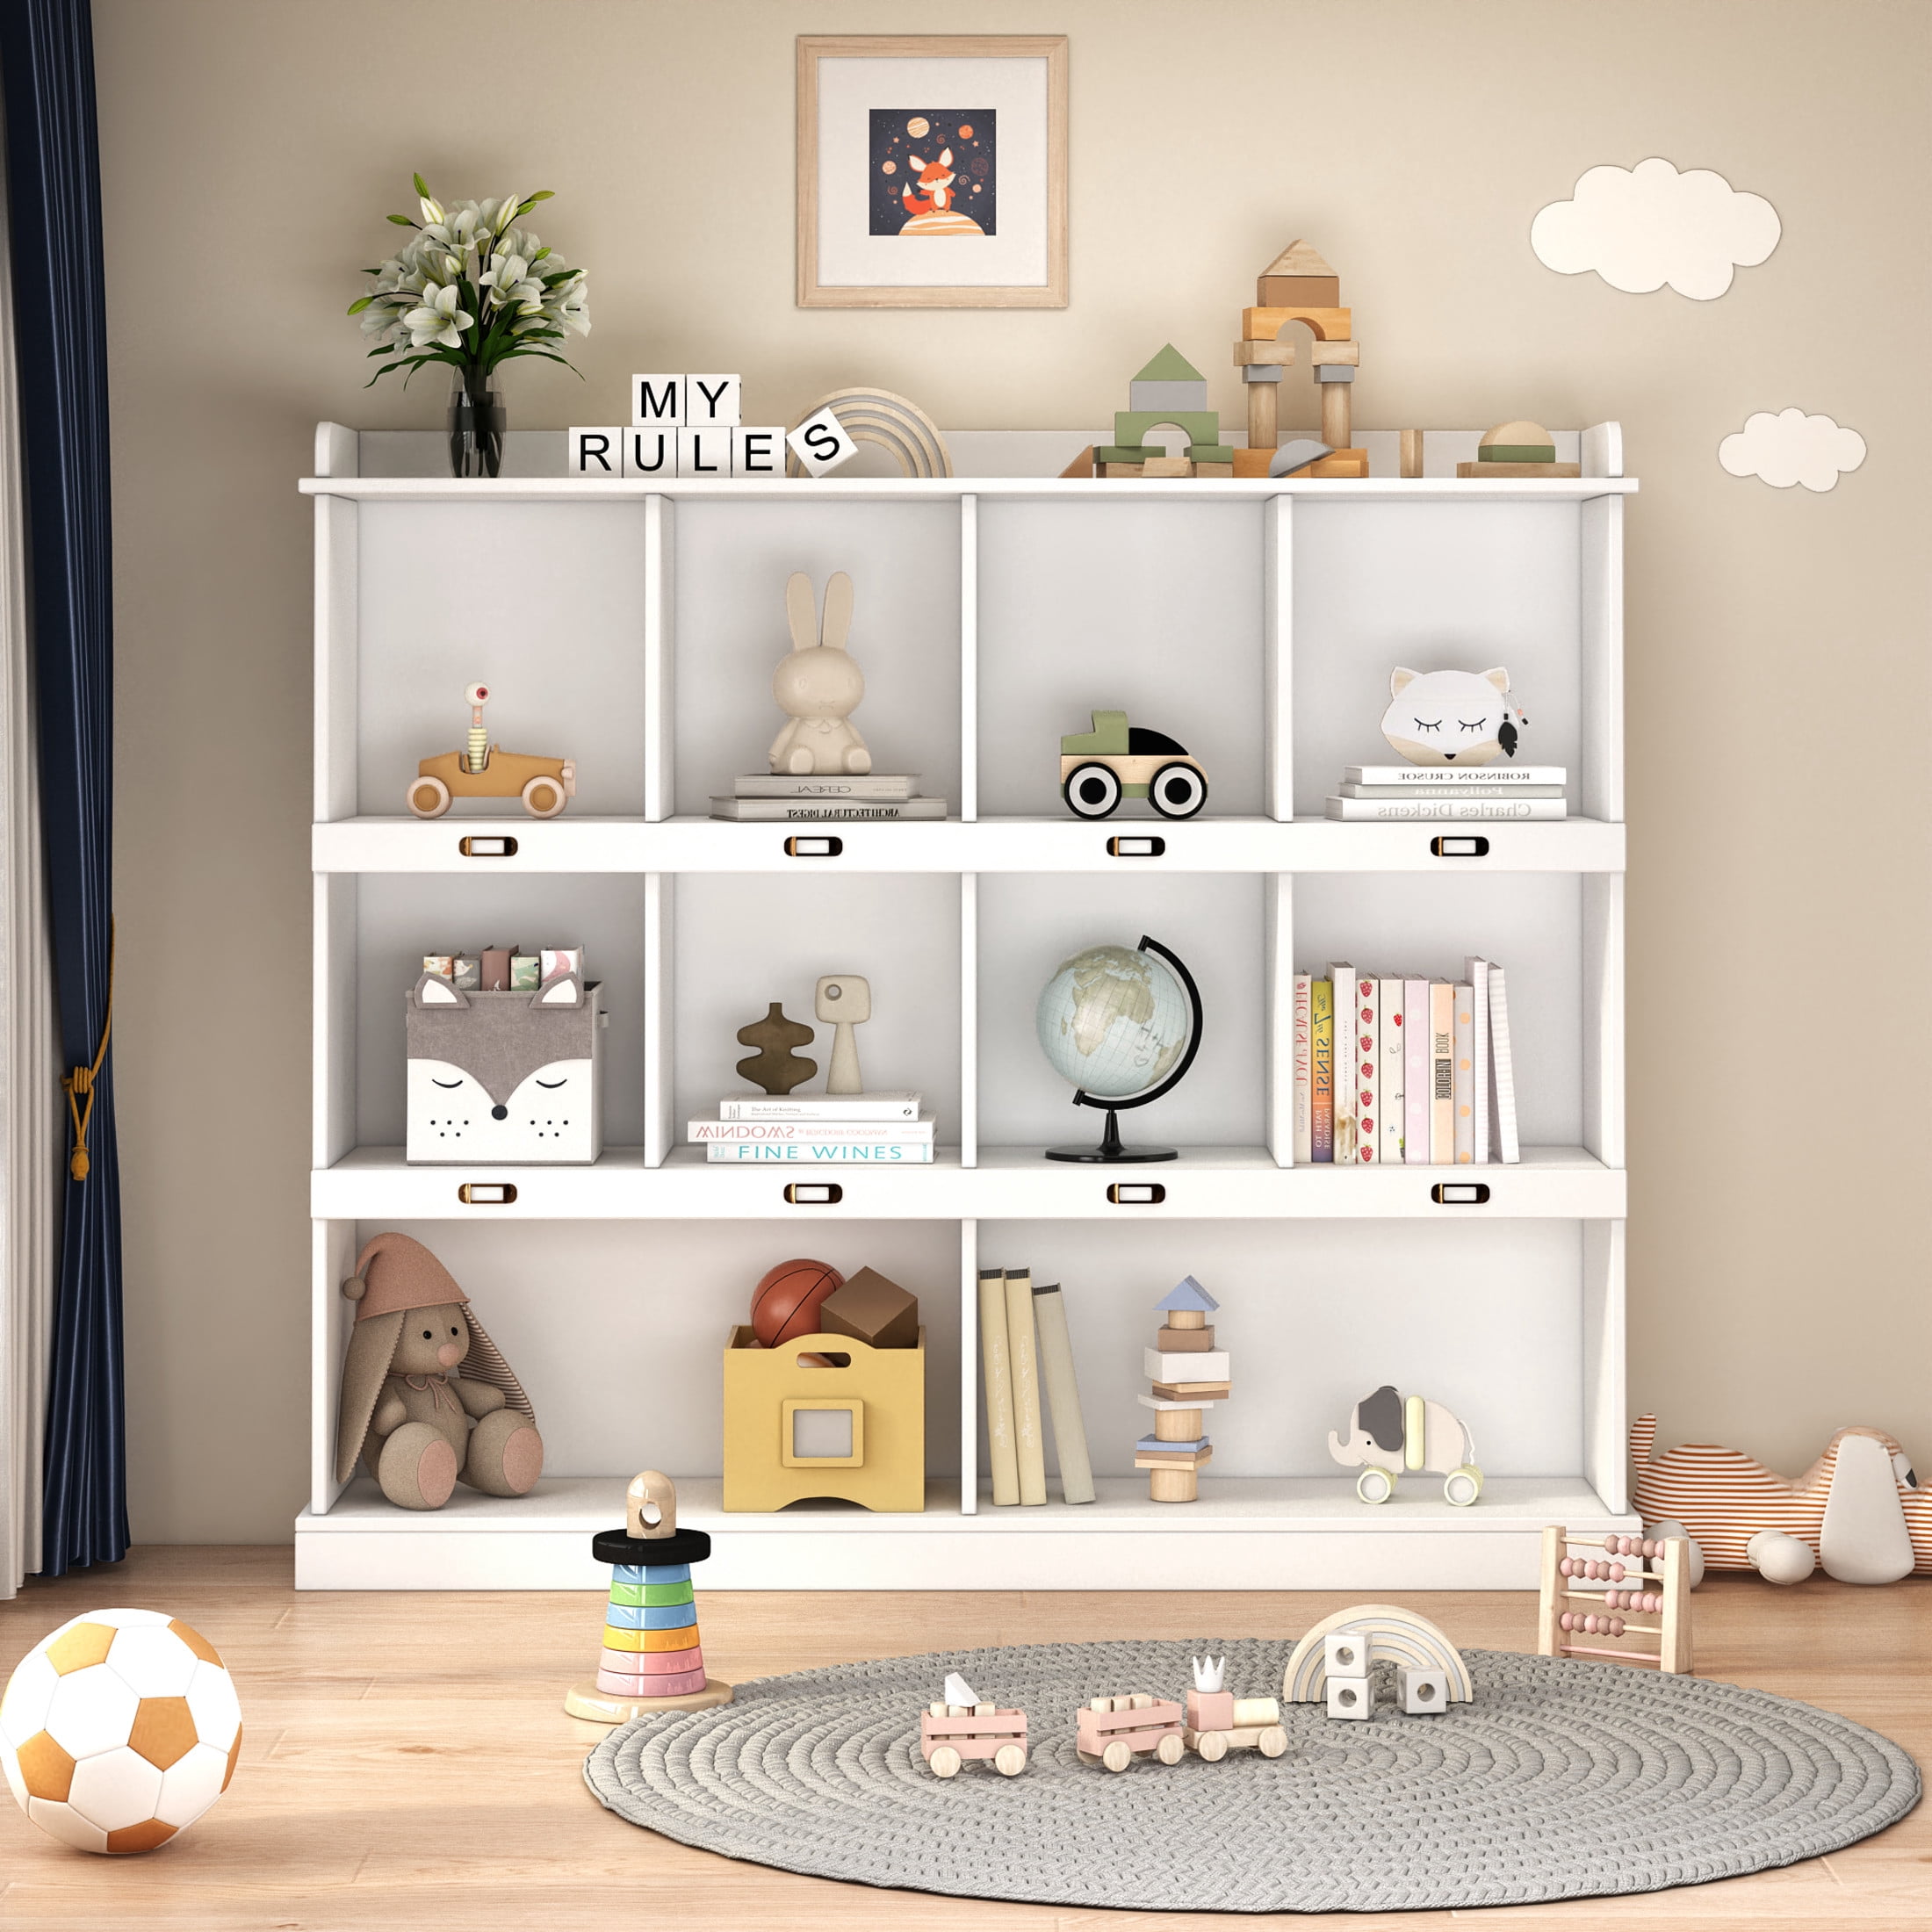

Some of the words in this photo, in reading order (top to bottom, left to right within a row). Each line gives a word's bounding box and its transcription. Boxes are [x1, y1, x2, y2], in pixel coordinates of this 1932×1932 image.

[641, 381, 729, 418] MY
[580, 423, 840, 472] RULES
[1435, 1032, 1450, 1054] BOOK
[739, 1145, 798, 1159] FINE
[812, 1145, 902, 1159] WINES
